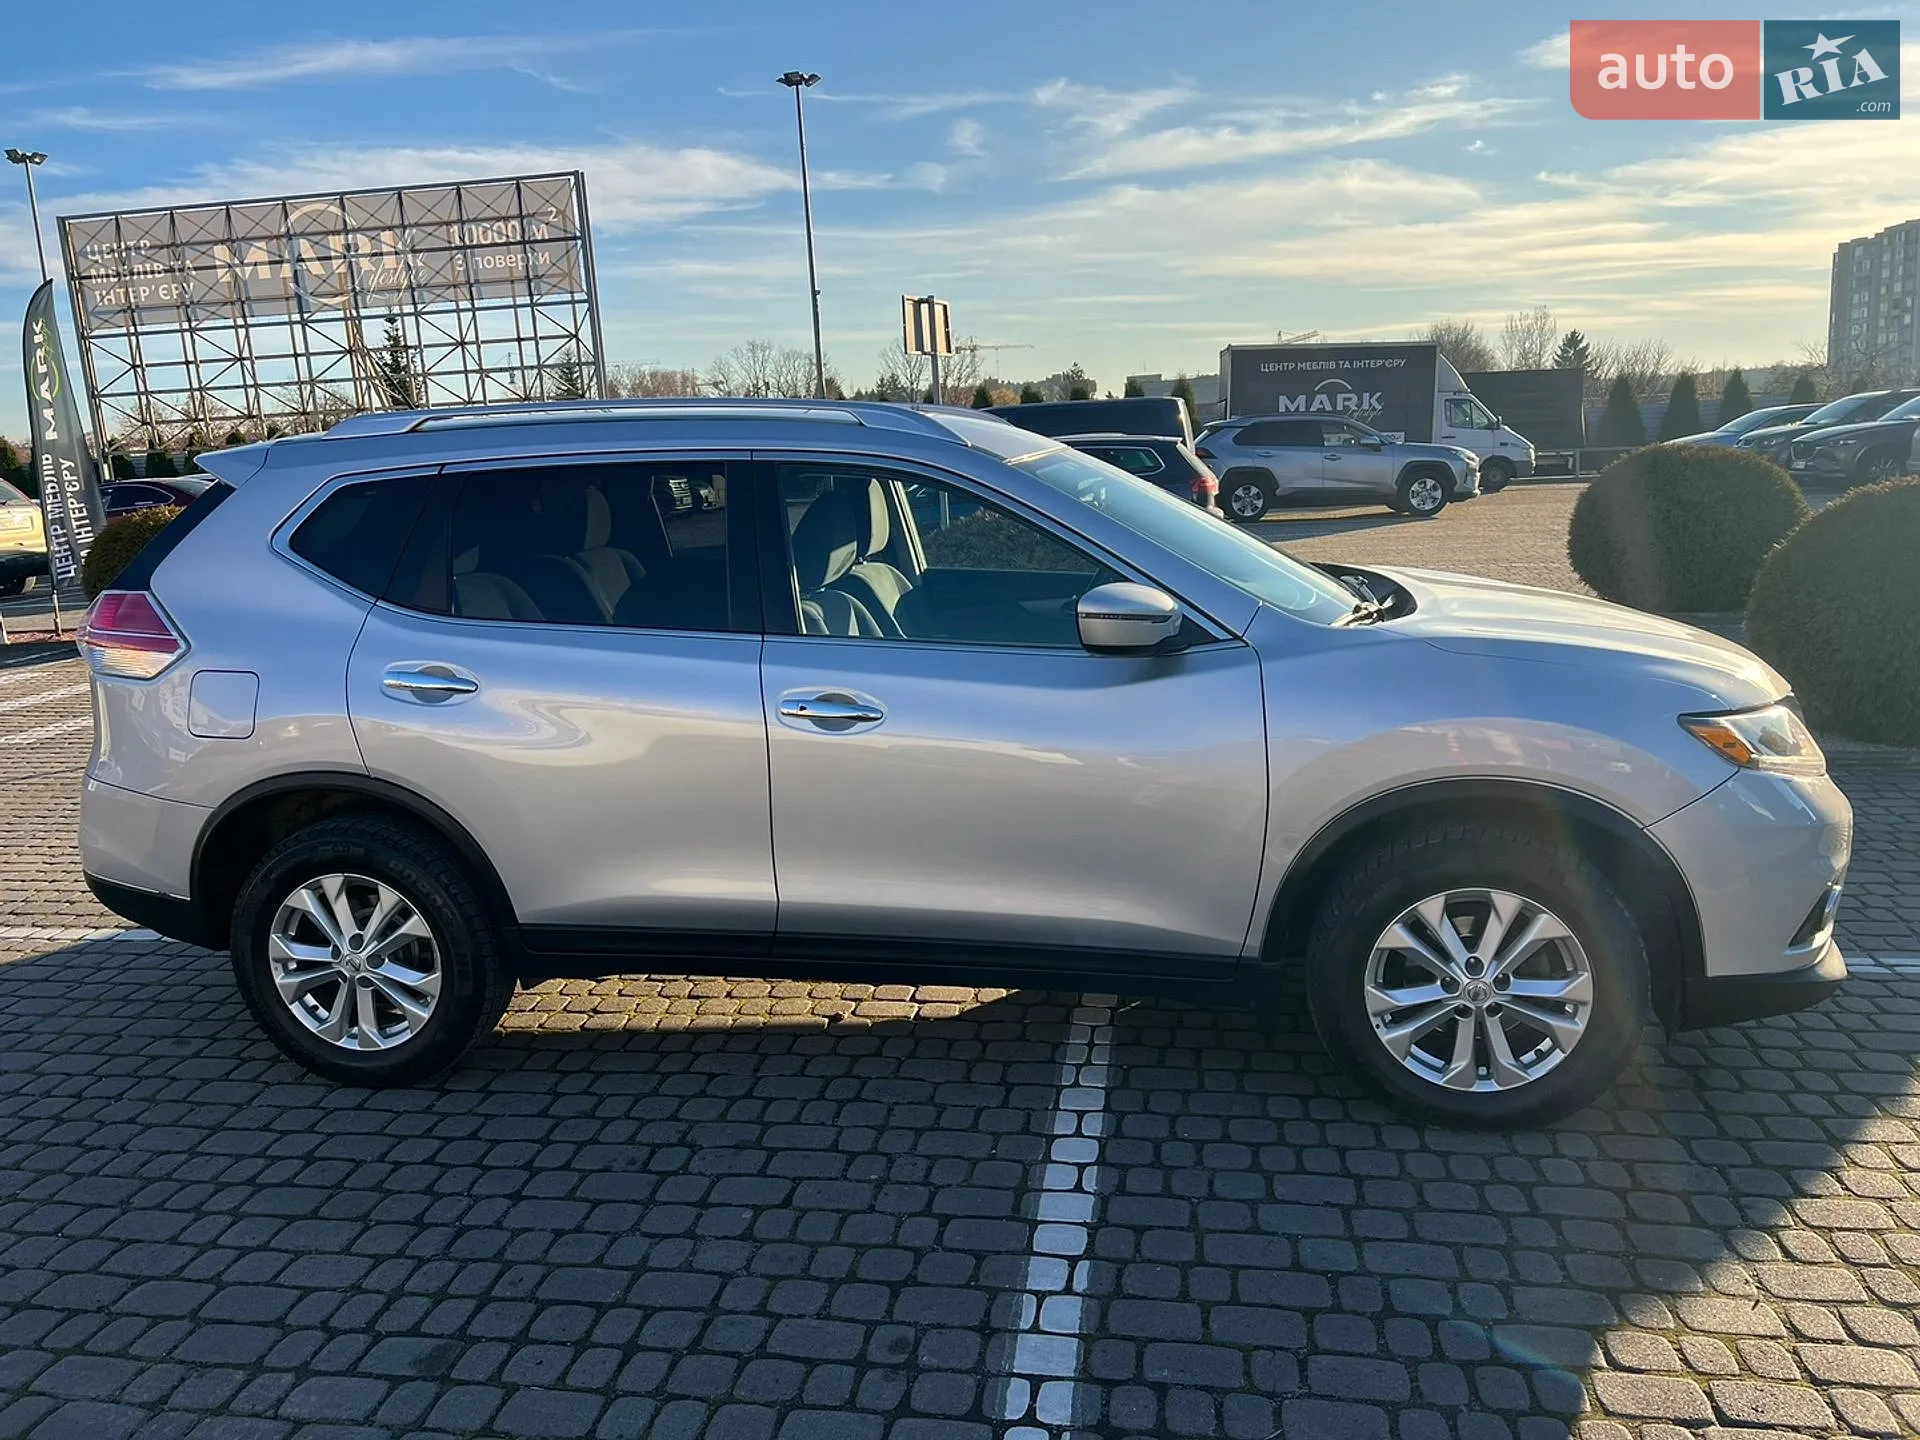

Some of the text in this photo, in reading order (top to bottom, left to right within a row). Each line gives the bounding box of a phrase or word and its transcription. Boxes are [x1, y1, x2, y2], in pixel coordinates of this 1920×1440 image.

[86, 239, 151, 263] ЦЕНТР
[213, 229, 427, 283] MARK
[32, 318, 58, 440] MARK
[1261, 362, 1295, 372] ЦЕНТР
[1297, 360, 1336, 371] МЕБЛІВ
[1339, 360, 1351, 369] ТА
[1278, 391, 1383, 413] MARK
[51, 524, 78, 580] ЦЕНТР
